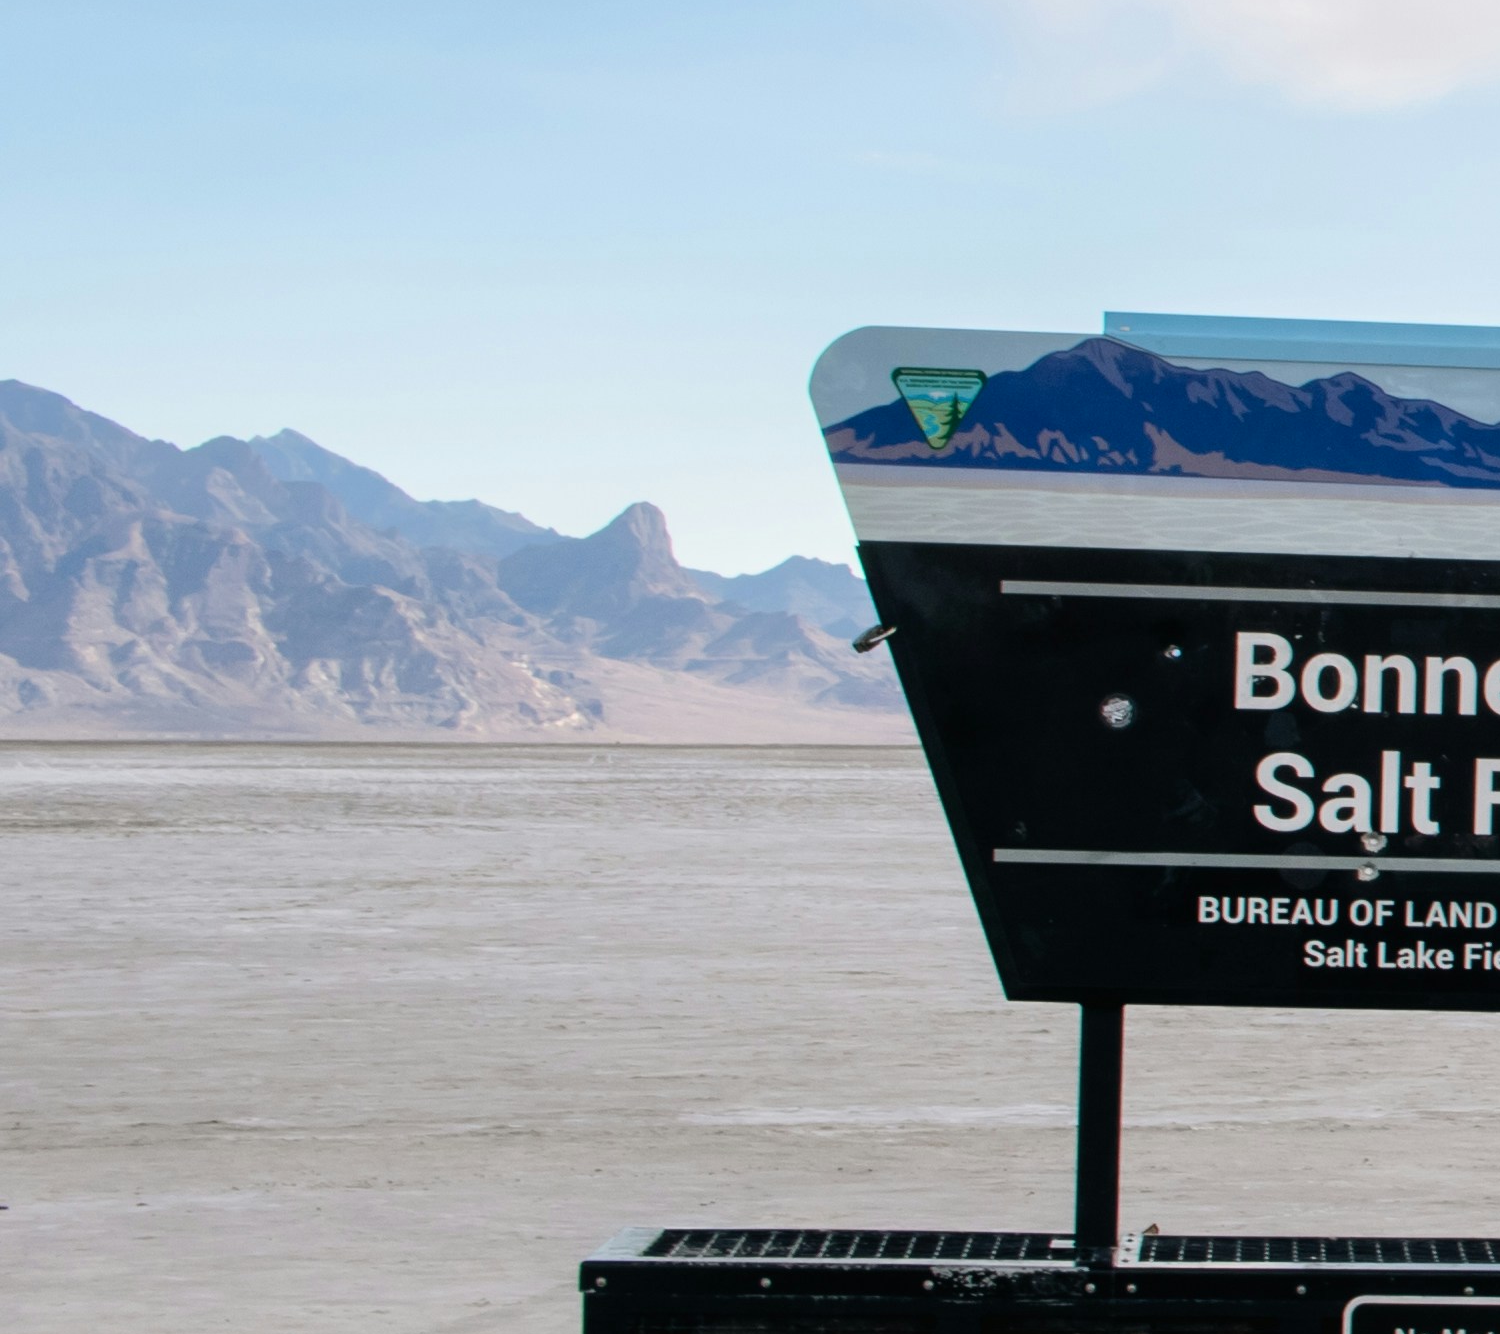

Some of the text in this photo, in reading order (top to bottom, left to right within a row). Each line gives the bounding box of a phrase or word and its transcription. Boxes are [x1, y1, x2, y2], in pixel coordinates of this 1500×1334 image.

[1253, 750, 1440, 835] Salt
[1198, 896, 1338, 926] BUREAU
[1349, 899, 1395, 927] OF
[1405, 900, 1497, 929] LAND
[1303, 939, 1368, 968] Salt
[1377, 940, 1454, 970] Lake
